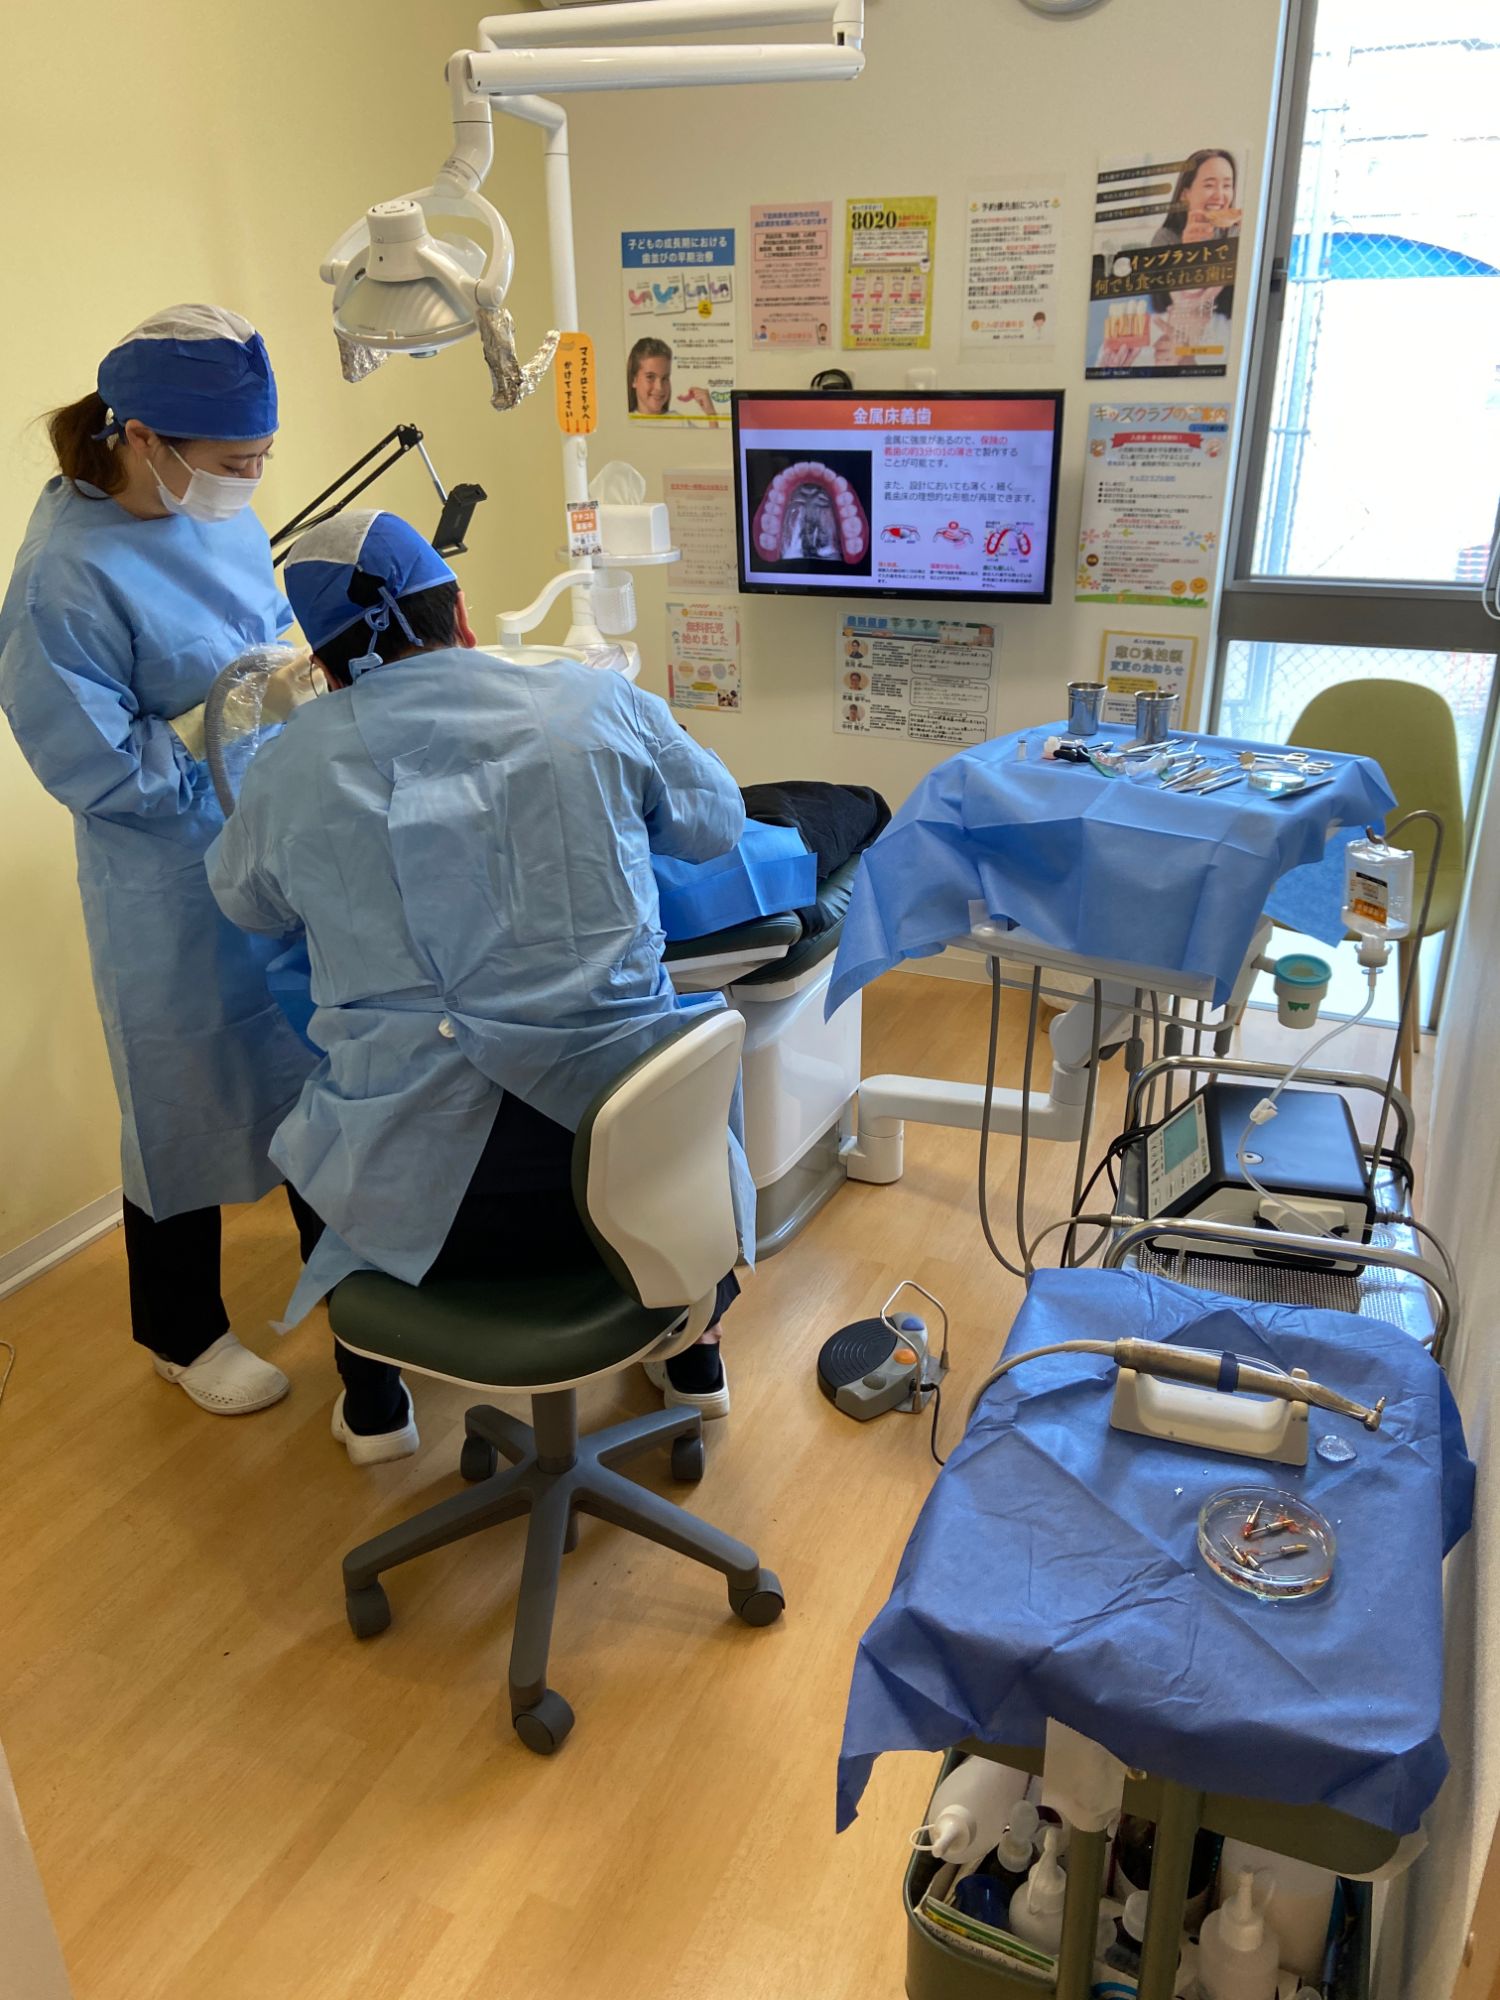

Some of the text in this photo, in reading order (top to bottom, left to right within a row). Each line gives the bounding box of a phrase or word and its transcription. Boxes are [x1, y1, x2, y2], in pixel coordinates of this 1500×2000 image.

[851, 210, 897, 230] 8020
[627, 236, 728, 250] 子どもの成長期における
[642, 251, 714, 264] 歯並びの早期治療
[1131, 244, 1229, 270] インプラントで
[1095, 266, 1233, 296] 何でも食べられる歯に
[563, 361, 573, 418] かけて下さい
[853, 407, 931, 426] 金属床義歯
[1095, 405, 1228, 424] キッズクラブのご案内
[884, 458, 949, 468] ことが可能です。
[682, 632, 729, 646] 始めました
[1110, 660, 1184, 676] 変更のお知らせ
